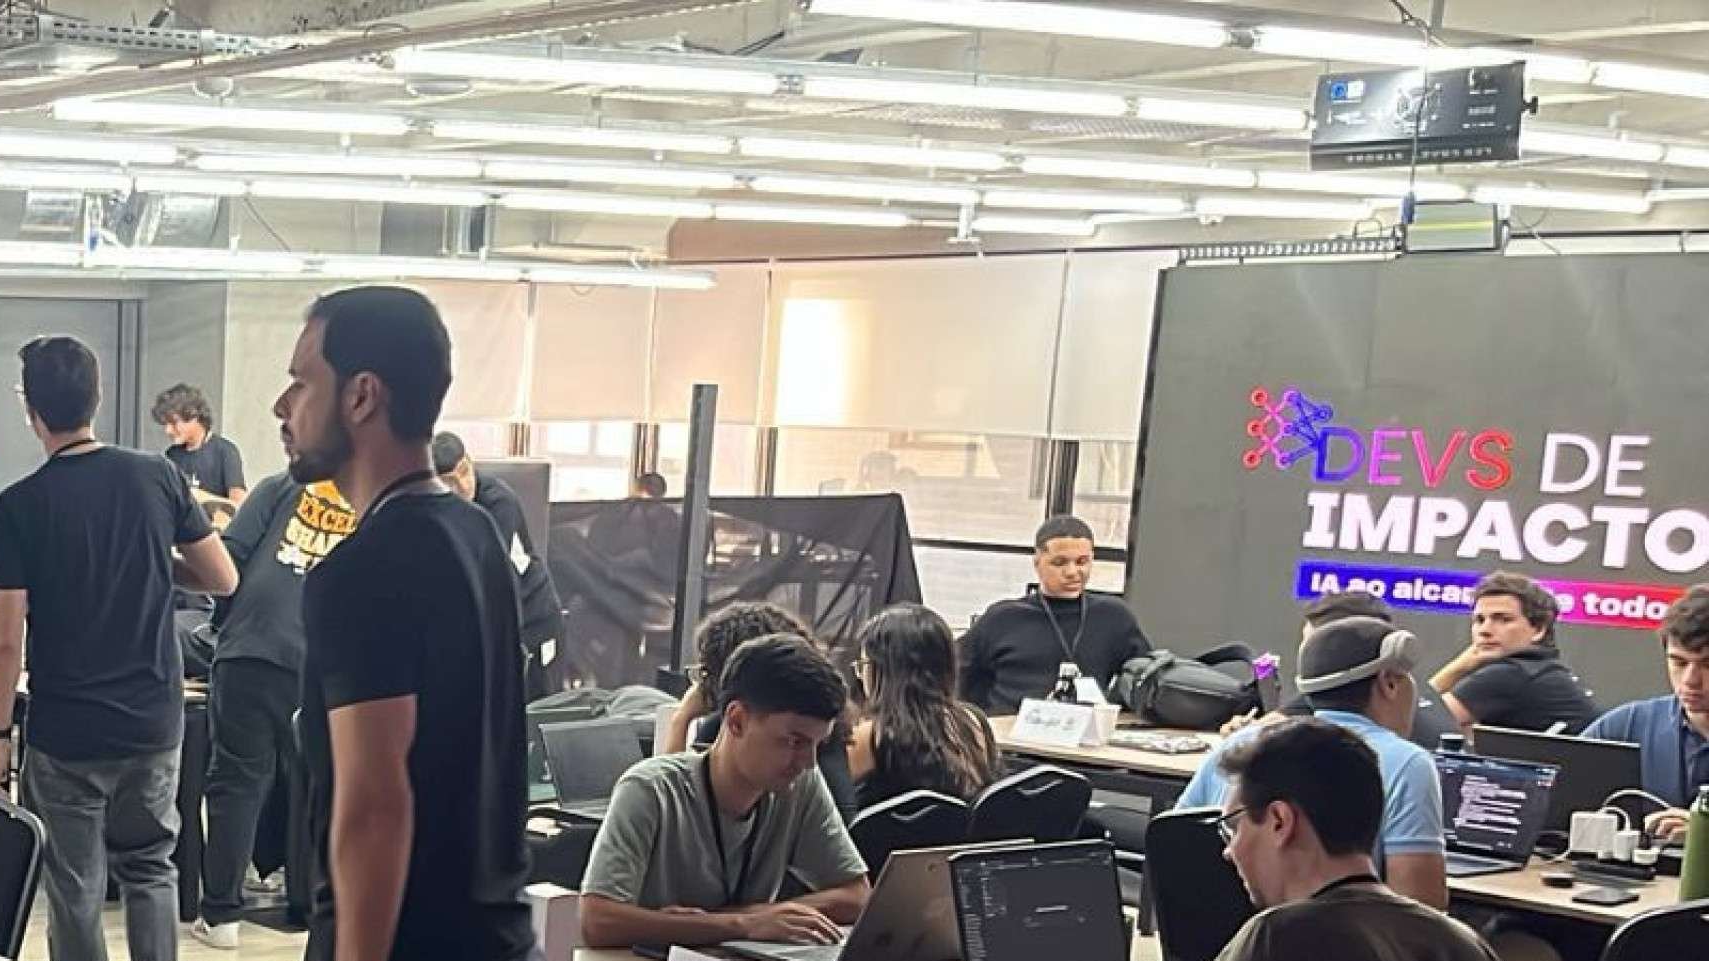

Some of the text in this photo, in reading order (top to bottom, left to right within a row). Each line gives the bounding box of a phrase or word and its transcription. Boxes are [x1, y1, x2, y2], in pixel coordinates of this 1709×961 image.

[1314, 426, 1652, 497] DEVS DE
[1302, 491, 1709, 573] IMPACTO
[1311, 571, 1340, 594] IA
[1392, 577, 1476, 604] alca
[1583, 592, 1668, 620] todo
